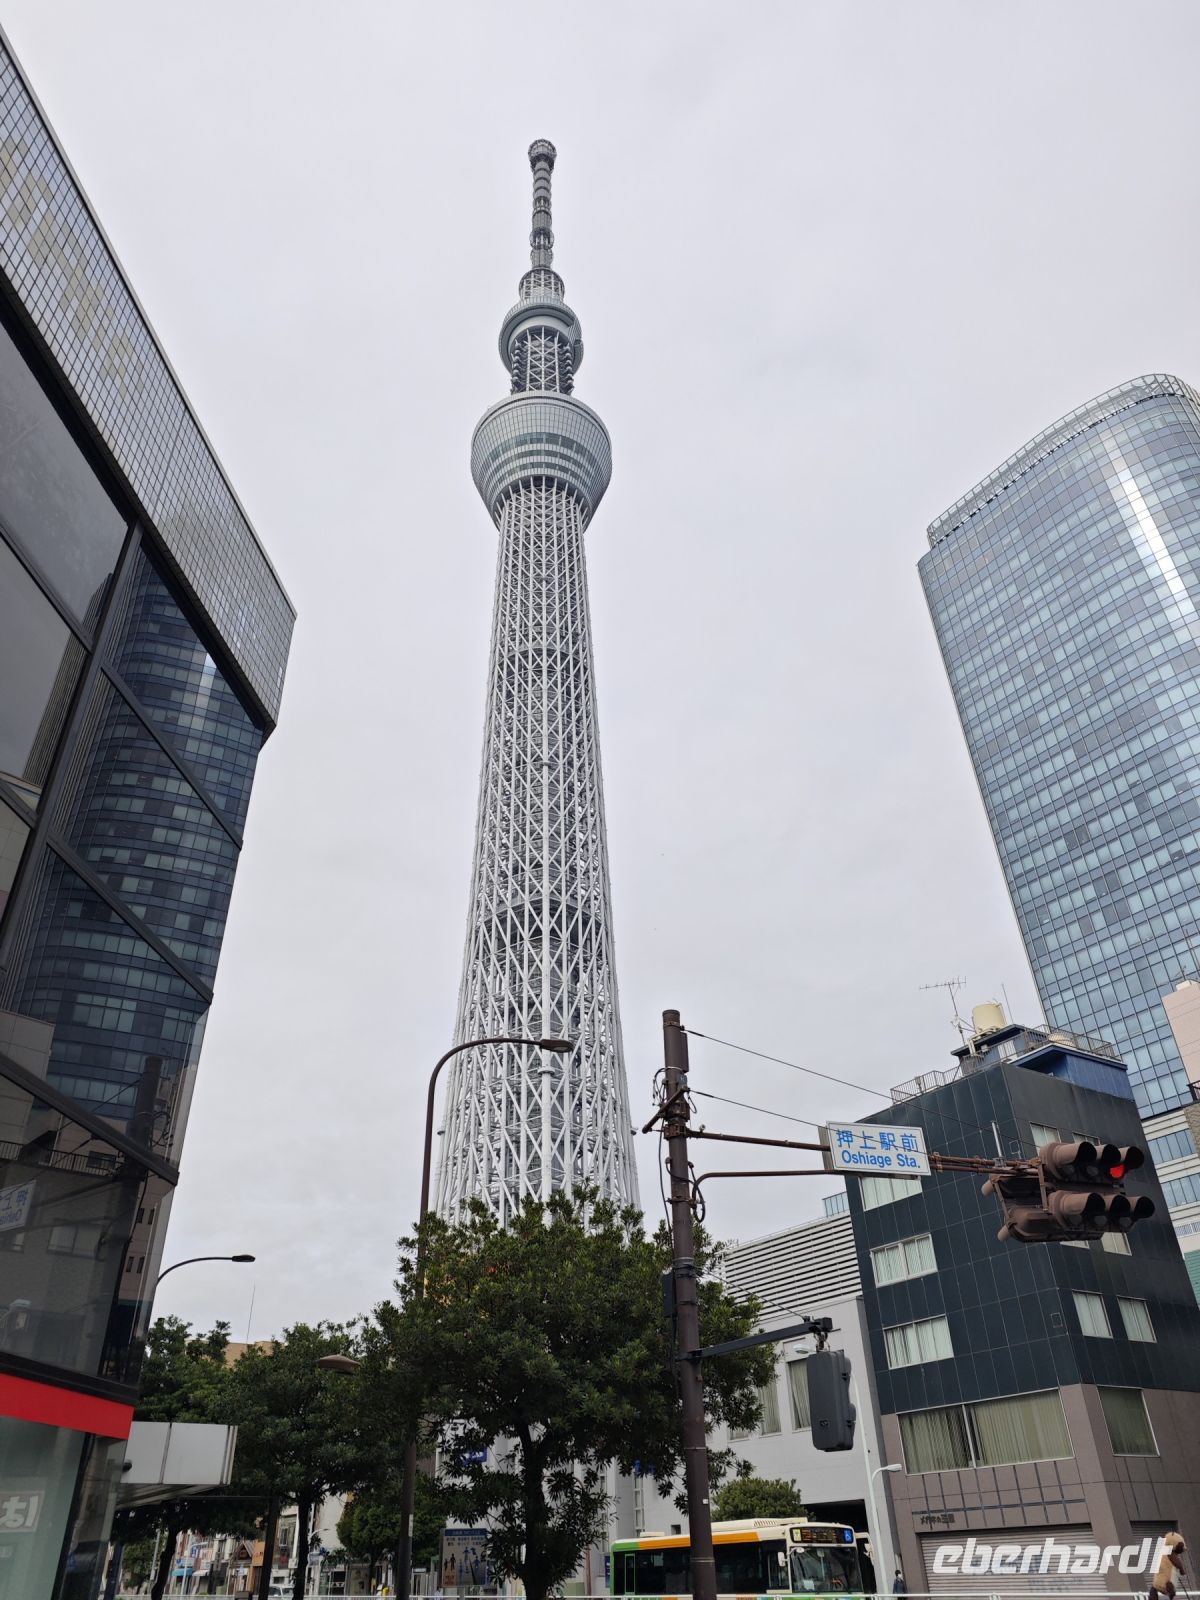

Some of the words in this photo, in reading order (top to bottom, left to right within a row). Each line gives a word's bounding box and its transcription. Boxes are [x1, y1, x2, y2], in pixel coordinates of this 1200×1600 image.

[836, 1129, 919, 1152] 押上駅前
[841, 1149, 892, 1168] Oshiage
[896, 1153, 921, 1169] Sta.
